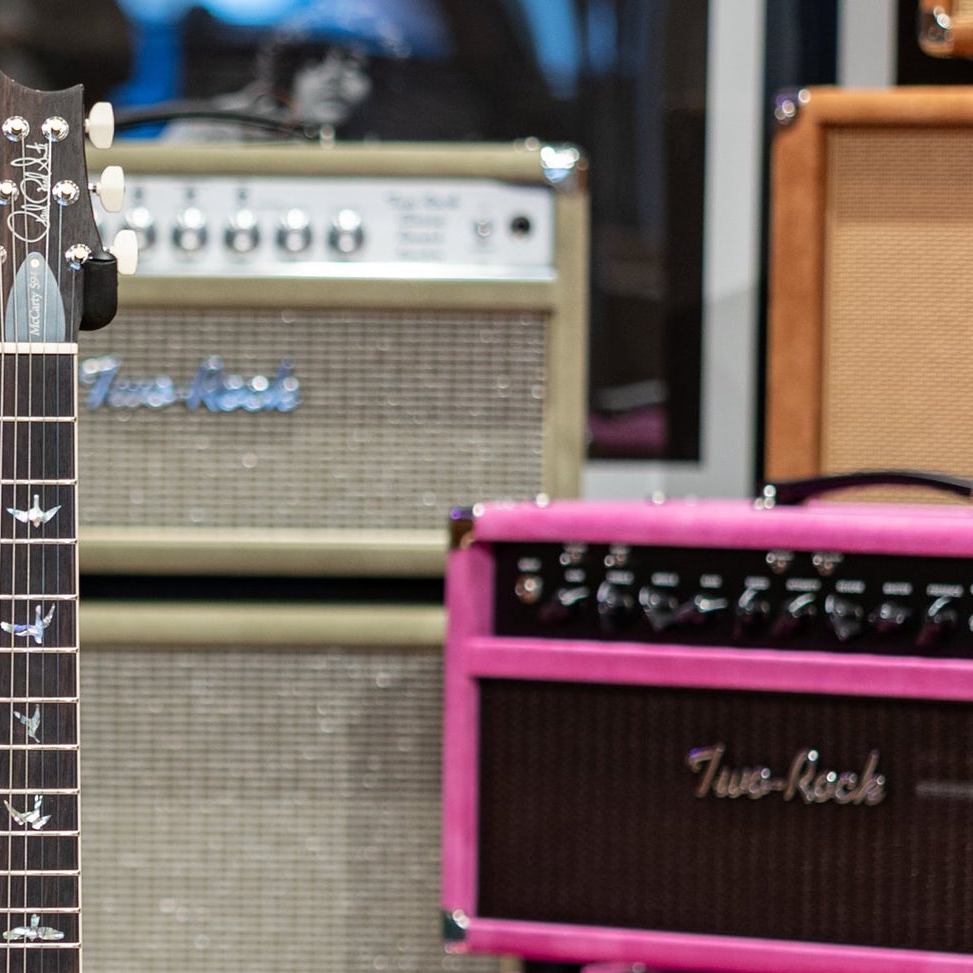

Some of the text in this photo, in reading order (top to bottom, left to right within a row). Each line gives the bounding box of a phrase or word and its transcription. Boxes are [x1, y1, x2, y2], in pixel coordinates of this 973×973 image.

[29, 291, 43, 337] McCarty
[79, 355, 303, 412] Two-Rock
[686, 742, 886, 806] Two-Rock
